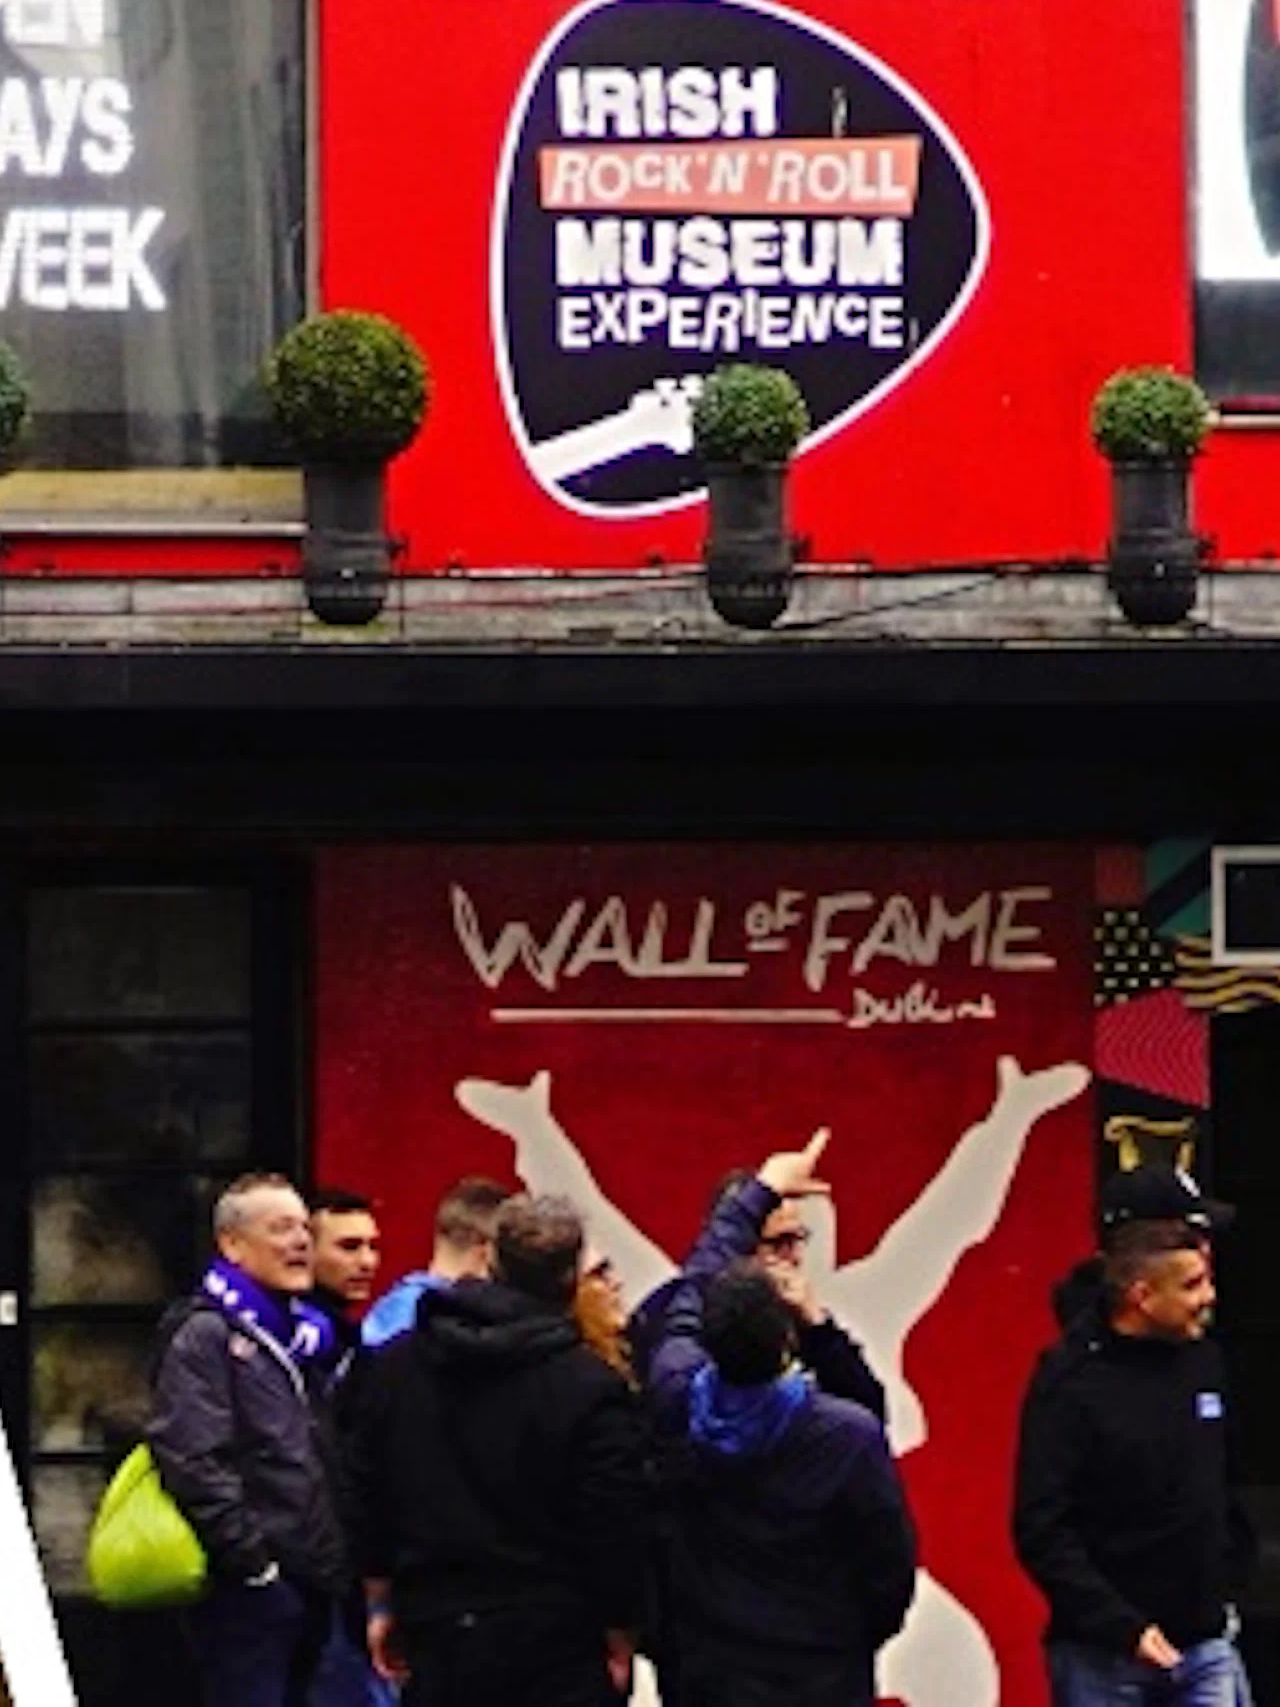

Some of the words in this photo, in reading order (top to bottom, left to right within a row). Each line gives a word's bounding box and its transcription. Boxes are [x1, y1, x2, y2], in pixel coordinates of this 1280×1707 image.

[555, 66, 778, 138] IRISH
[555, 217, 904, 287] MUSEUM
[558, 289, 905, 352] EXPERIENCE
[450, 882, 749, 990] WALL
[744, 889, 806, 951] OF
[802, 888, 1057, 992] FAME
